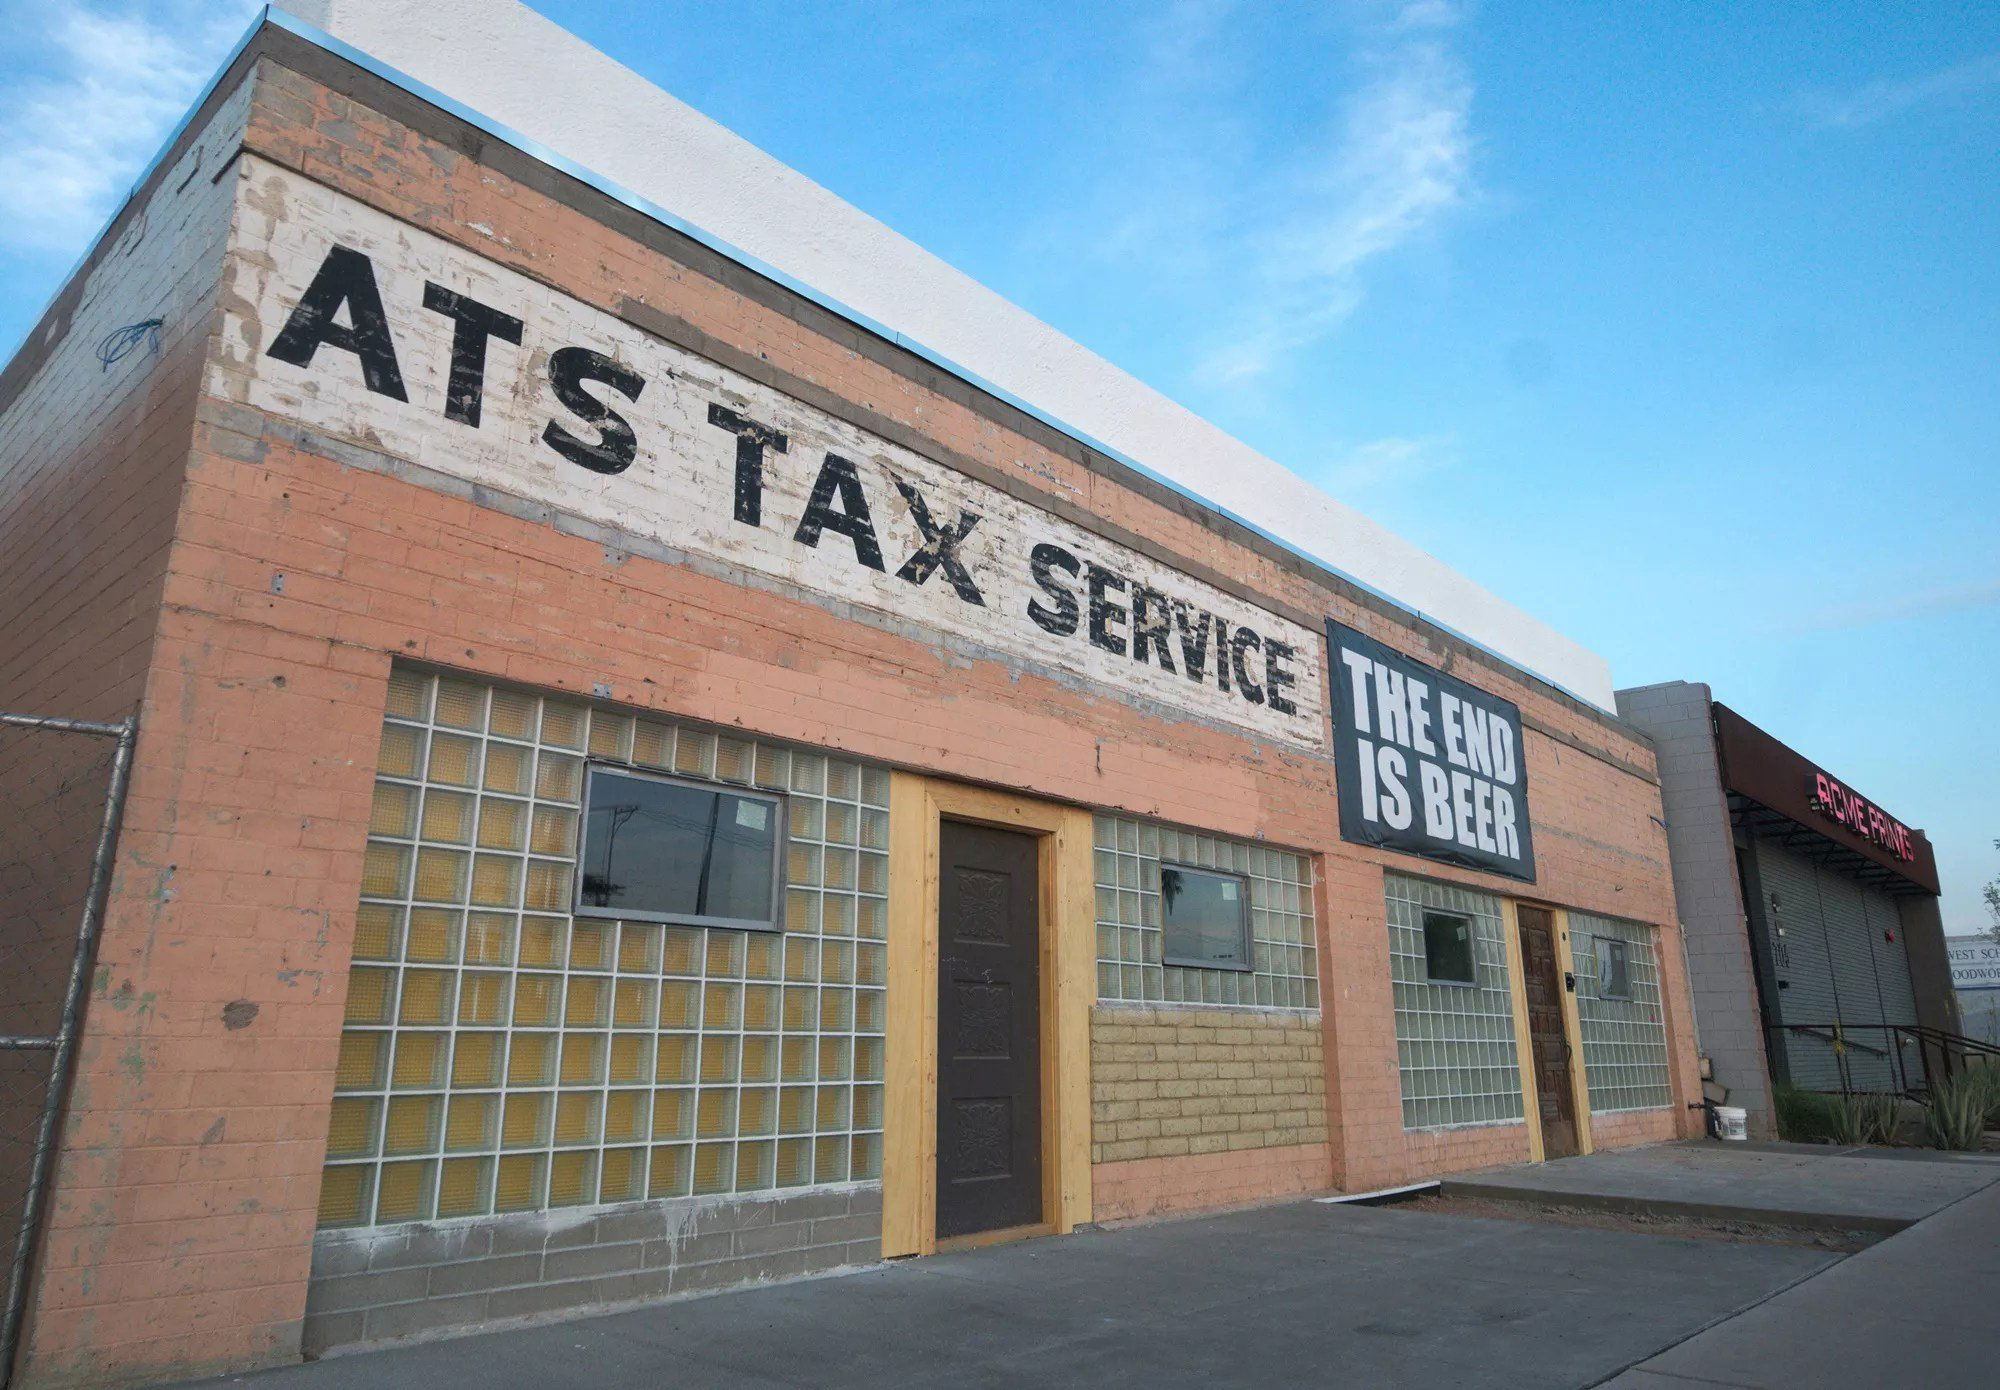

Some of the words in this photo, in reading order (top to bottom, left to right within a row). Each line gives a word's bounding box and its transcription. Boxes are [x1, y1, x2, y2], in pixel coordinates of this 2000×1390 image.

[266, 242, 647, 475] ATS
[707, 402, 986, 607] TAX
[1027, 543, 1298, 716] SERVICE
[1341, 647, 1436, 757] THE
[1440, 691, 1516, 785] END
[1357, 738, 1413, 830] IS
[1419, 759, 1521, 860] BEER
[1816, 772, 1869, 835] ACME
[1868, 805, 1915, 862] PRINTS
